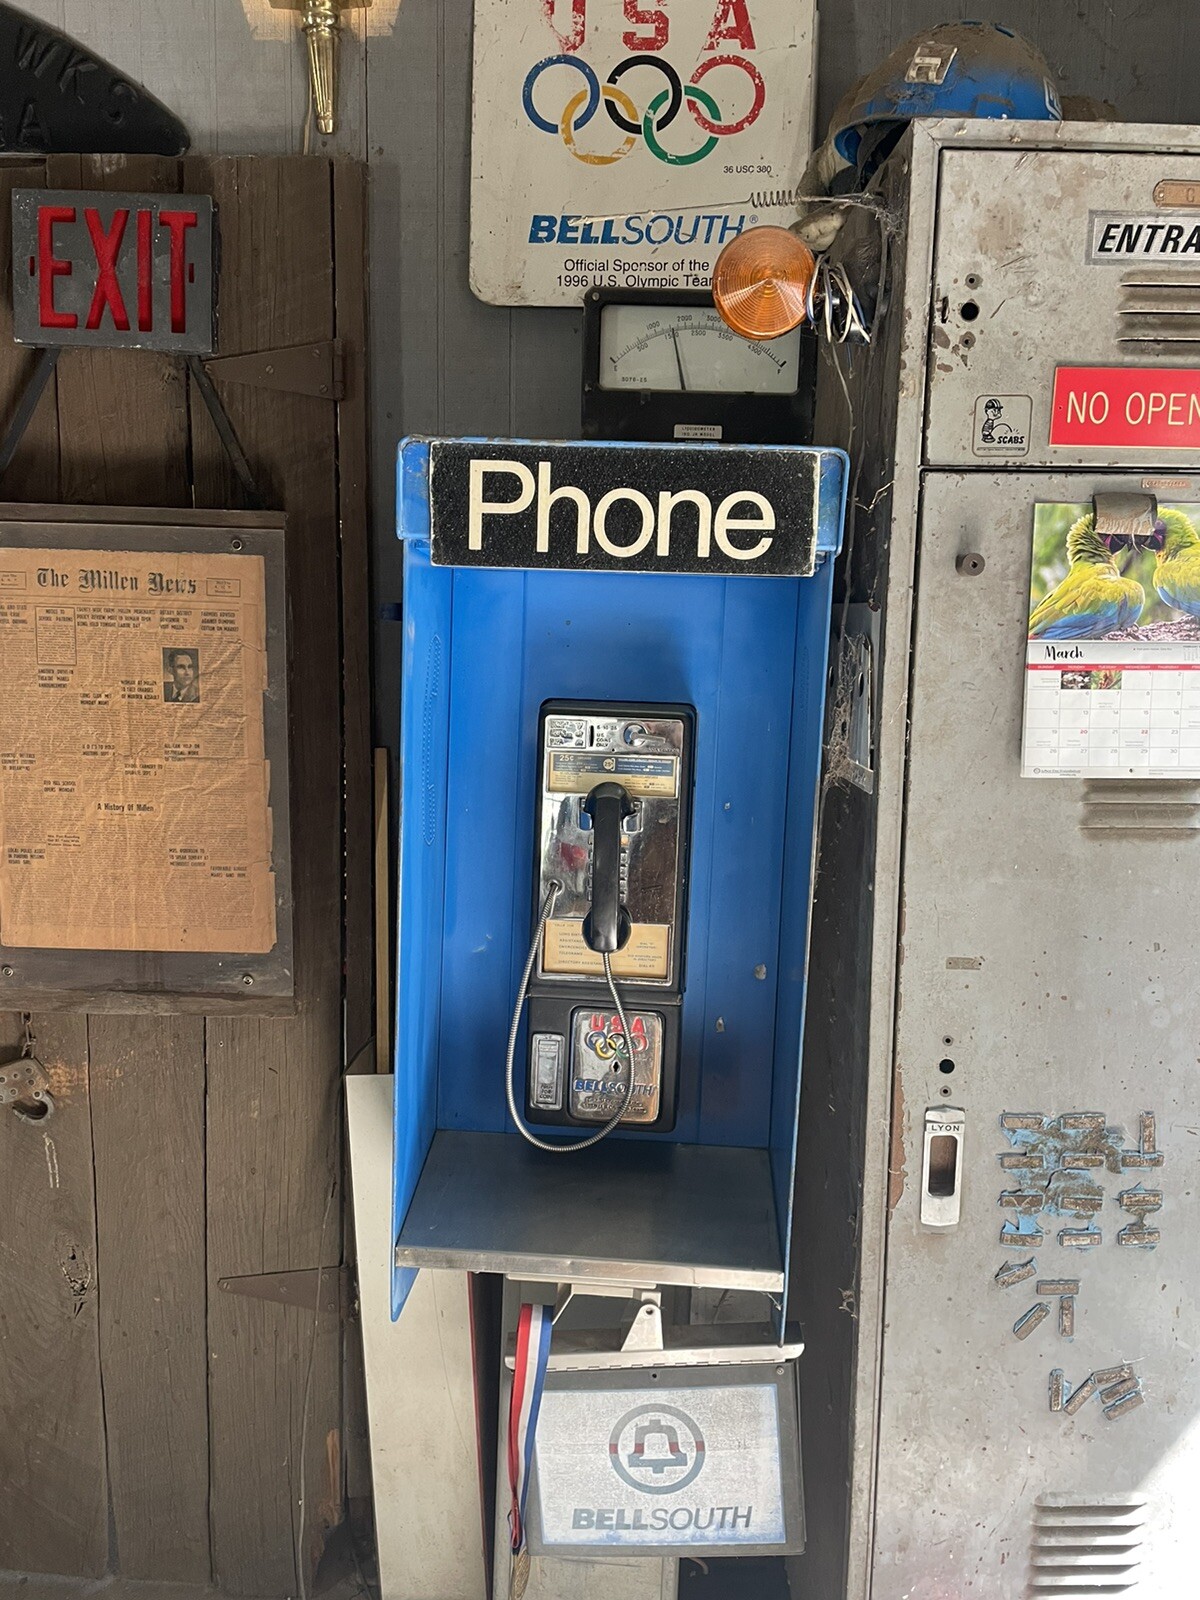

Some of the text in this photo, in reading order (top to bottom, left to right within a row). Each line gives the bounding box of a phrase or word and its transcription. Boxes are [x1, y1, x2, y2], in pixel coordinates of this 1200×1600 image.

[723, 165, 772, 174] 36 USC 380
[1097, 223, 1200, 253] ENTRA
[38, 206, 198, 334] EXIT
[563, 258, 710, 275] Official Sponsor of the
[556, 275, 590, 288] 1996
[593, 275, 621, 288] U.S.
[625, 275, 680, 288] Olympic
[676, 314, 693, 323] 2000
[706, 315, 722, 324] 3000
[690, 329, 707, 338] 2500
[636, 342, 650, 353] 500
[747, 344, 763, 357] 4500
[1066, 391, 1110, 425] NO
[996, 435, 1026, 445] SCABS
[467, 458, 777, 561] Phone
[37, 567, 70, 588] The
[78, 568, 139, 594] Millen
[147, 571, 198, 597] News
[1044, 645, 1085, 661] March
[97, 802, 103, 811] A
[104, 802, 125, 812] History
[590, 1013, 645, 1034] USA
[931, 1124, 960, 1132] LYON
[571, 1505, 754, 1531] BELLSOUTH
